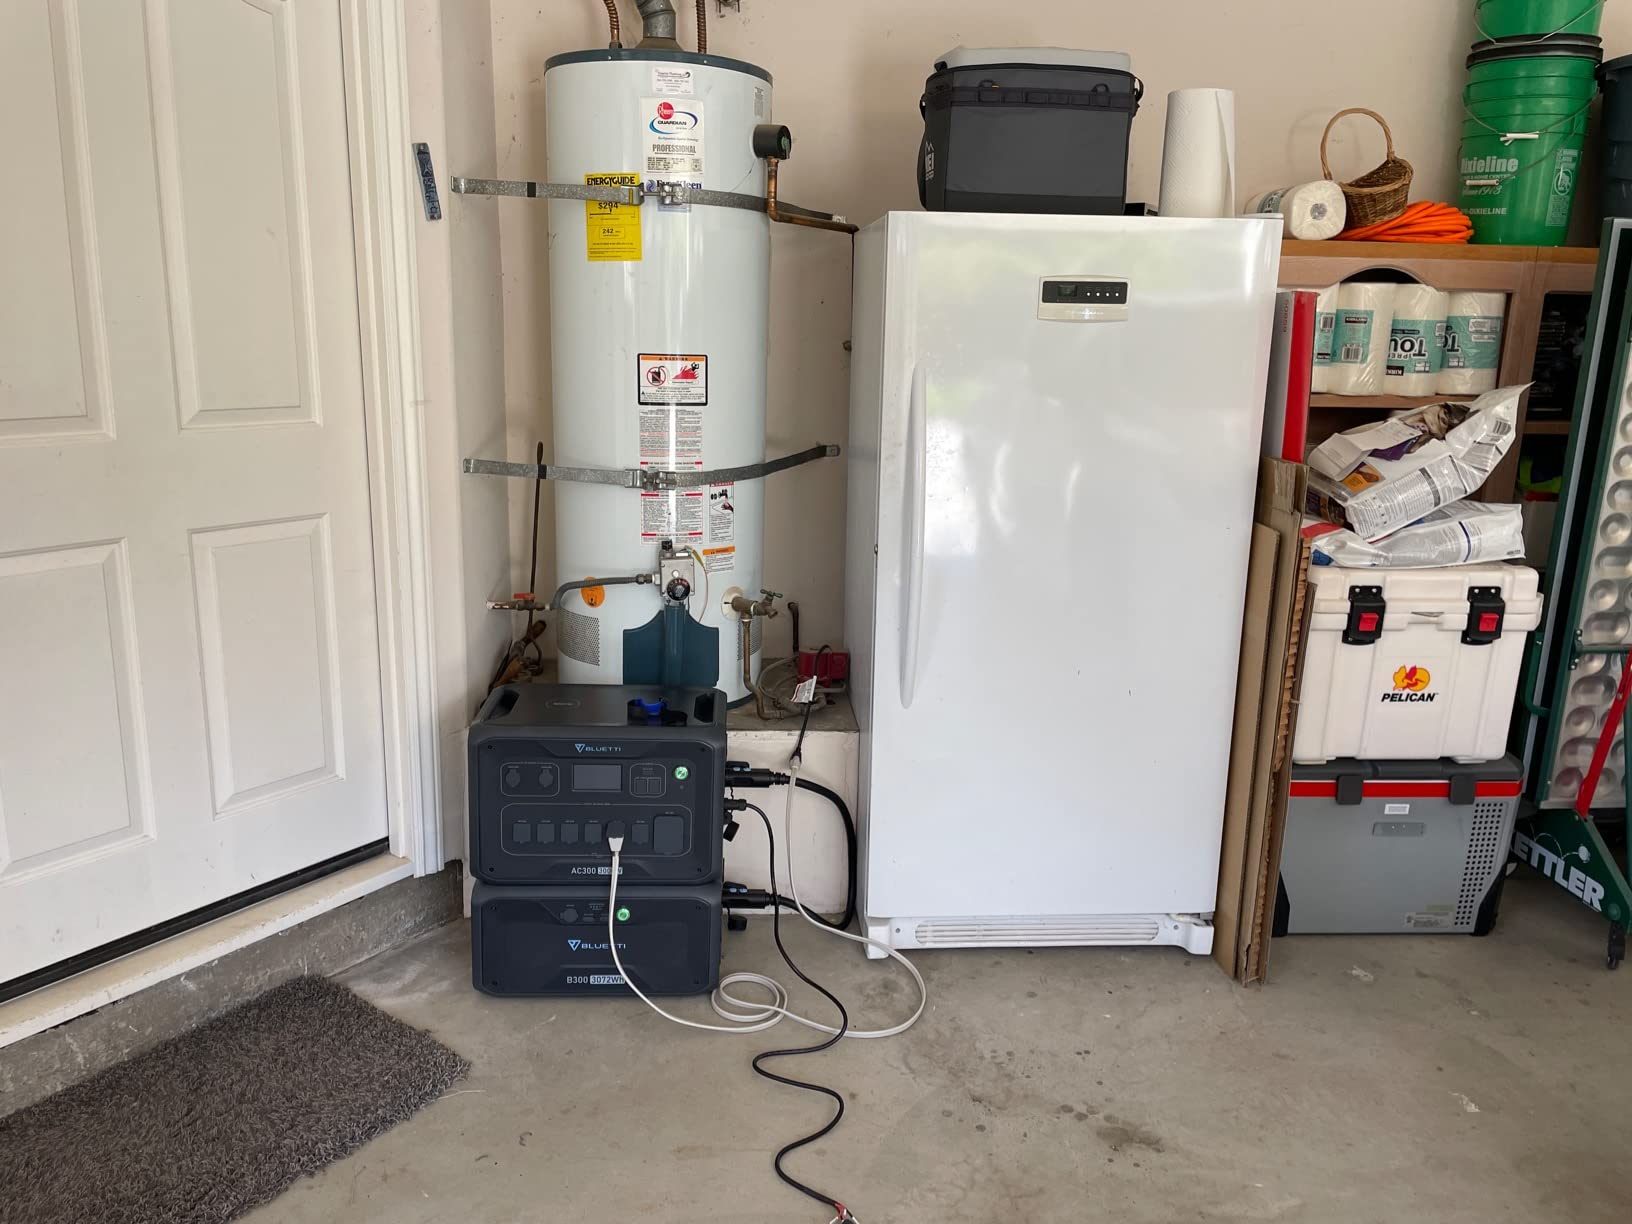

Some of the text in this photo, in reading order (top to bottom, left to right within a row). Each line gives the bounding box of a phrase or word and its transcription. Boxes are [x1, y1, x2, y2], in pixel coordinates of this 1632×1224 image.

[652, 144, 697, 153] PROFESSIONAL
[586, 176, 636, 187] ENERGYGUIDE
[1381, 692, 1436, 702] PELICAN
[571, 867, 597, 875] AC300
[1513, 831, 1603, 913] ETTLER
[566, 976, 589, 984] B300
